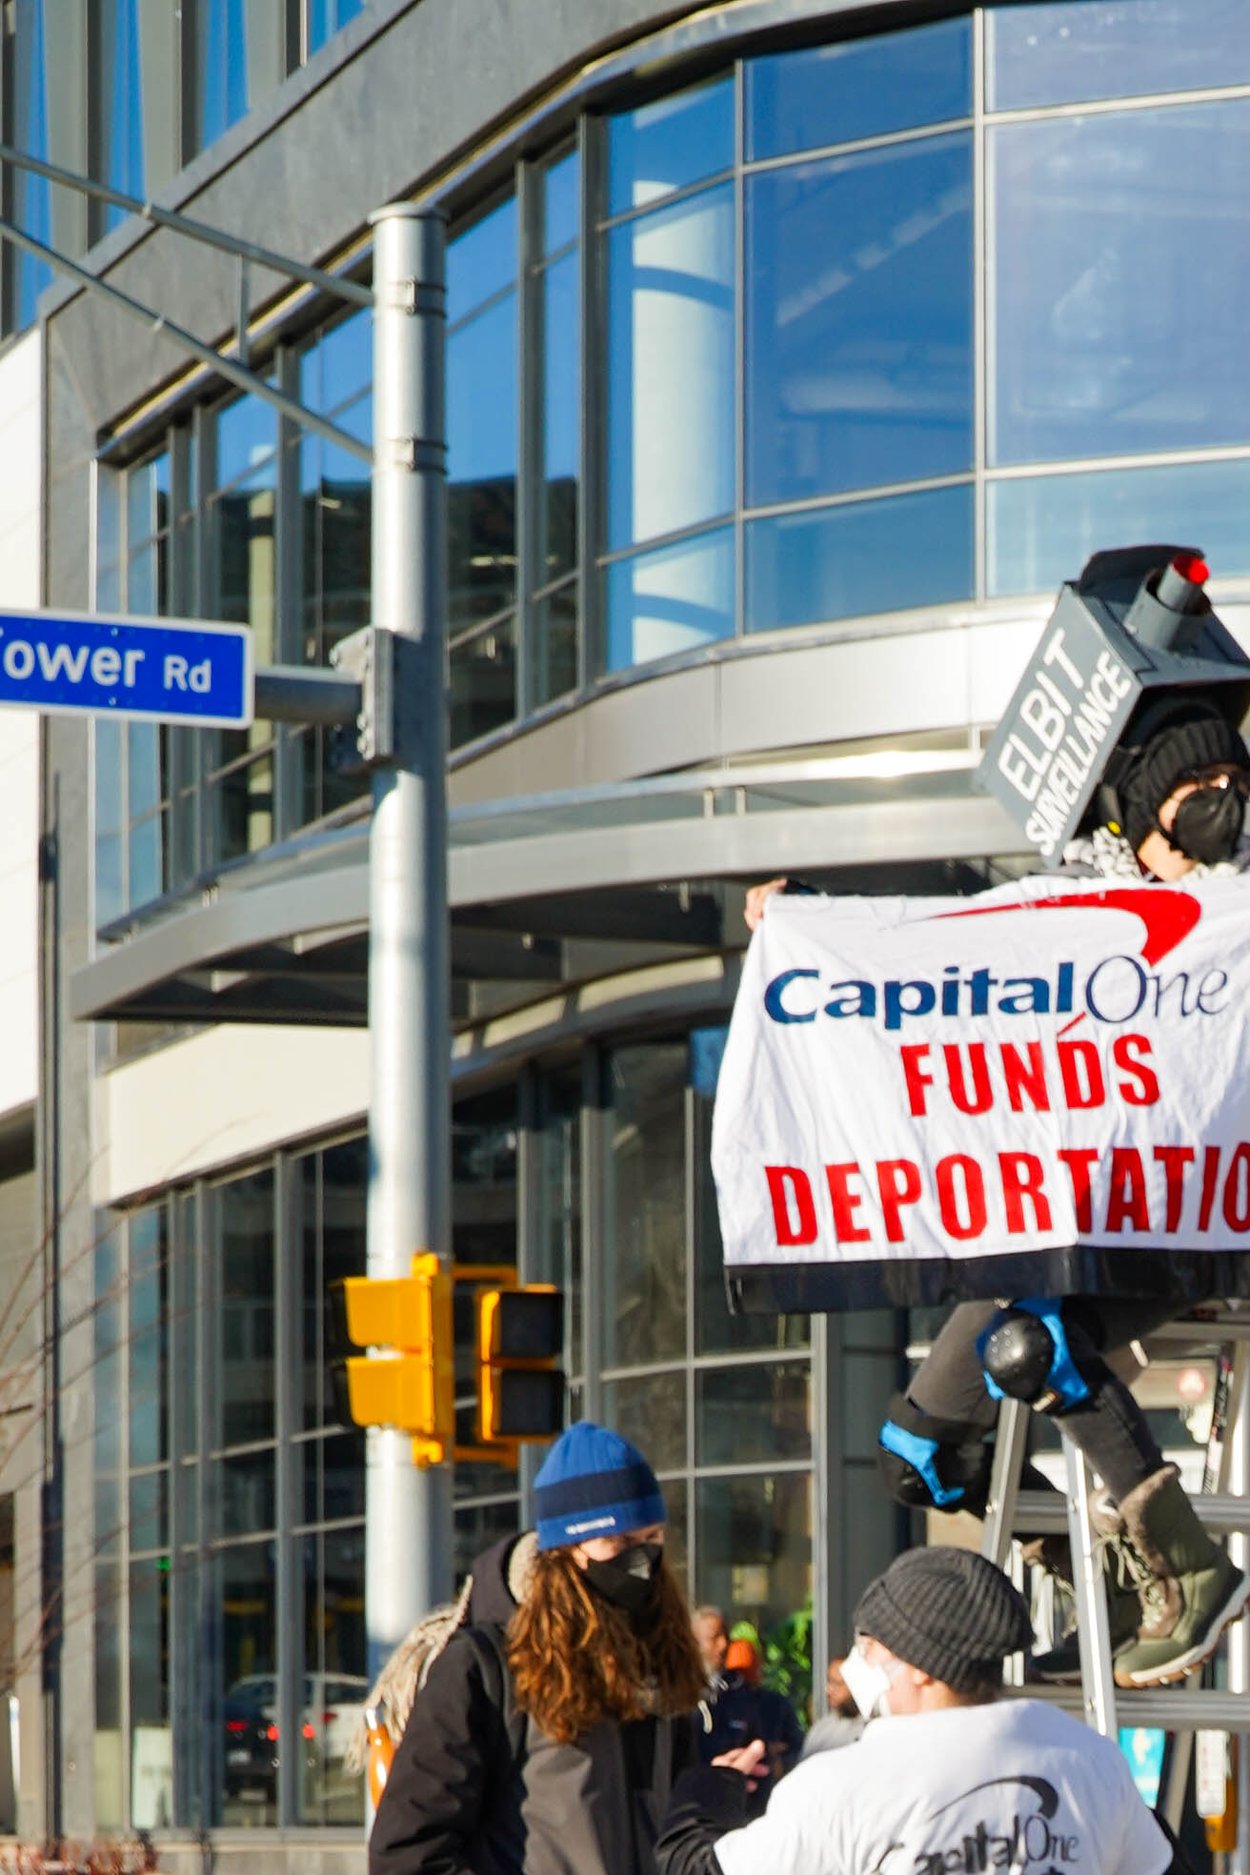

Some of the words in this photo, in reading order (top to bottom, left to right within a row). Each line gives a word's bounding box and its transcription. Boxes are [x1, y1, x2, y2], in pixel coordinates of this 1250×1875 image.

[0, 626, 145, 687] ower
[164, 654, 211, 693] Rd
[998, 627, 1084, 801] ELBIT
[1025, 650, 1132, 856] SURVEILLANCE
[900, 1033, 1161, 1117] FUNDS
